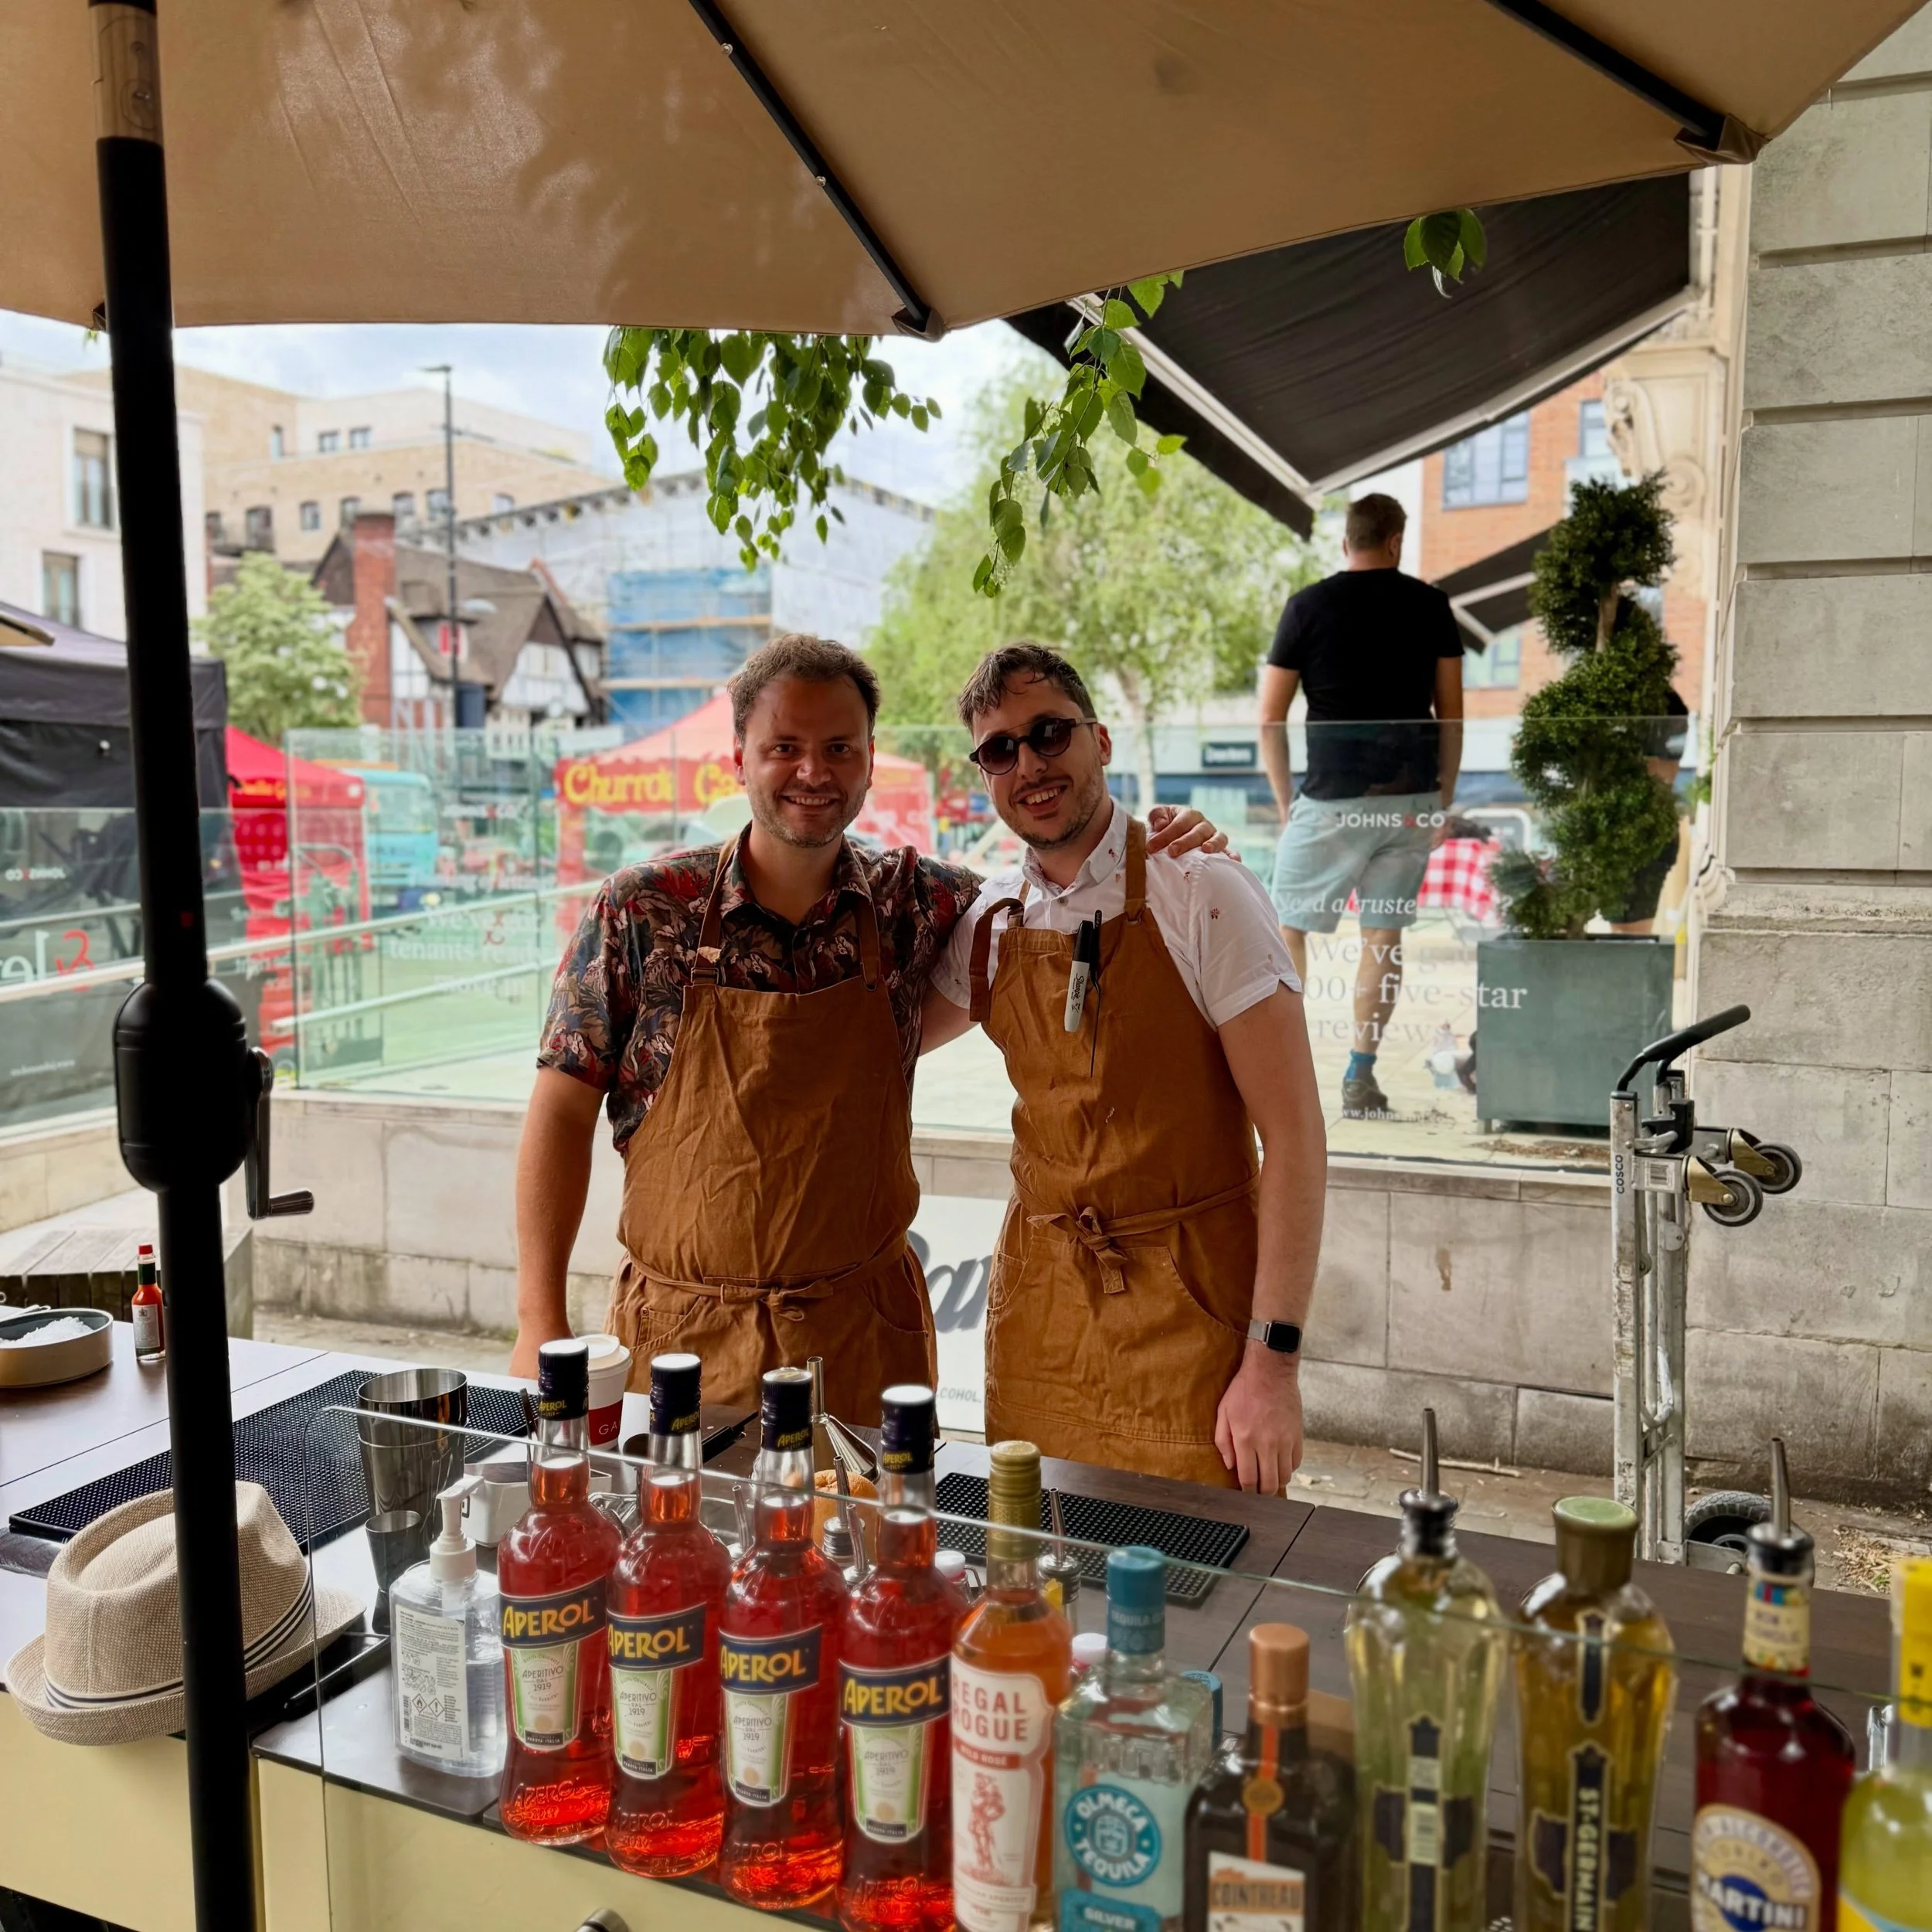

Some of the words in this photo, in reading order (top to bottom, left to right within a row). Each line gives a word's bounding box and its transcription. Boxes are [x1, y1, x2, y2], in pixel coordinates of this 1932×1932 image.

[1335, 813, 1445, 829] JOHNS&CO
[1307, 935, 1403, 966] We've
[1304, 975, 1367, 1002] 00+
[1379, 973, 1529, 1009] five-star
[1614, 1155, 1625, 1195] COSCO
[938, 1386, 982, 1403] COHOL.
[539, 1400, 567, 1413] APEROL
[671, 1410, 700, 1430] APERO
[883, 1452, 913, 1464] APEROL
[503, 1599, 594, 1639] APEROL
[607, 1623, 690, 1659] APEROL
[522, 1665, 563, 1679] APERITIVO
[719, 1645, 808, 1682] APEROL
[533, 1682, 552, 1692] 1919
[620, 1691, 657, 1702] APERITIVO
[843, 1675, 943, 1716] APEROL
[951, 1672, 1027, 1715] REGAL
[628, 1707, 646, 1716] 1919
[733, 1716, 772, 1728] APERITIVO
[743, 1732, 760, 1741] 1919
[864, 1749, 909, 1762] APERITIVO
[875, 1767, 896, 1777] 1919
[1075, 1792, 1148, 1832] OLMECA
[1075, 1837, 1151, 1881] TEQUILA
[1697, 1869, 1805, 1929] MARTINI
[1083, 1906, 1136, 1931] SILVER
